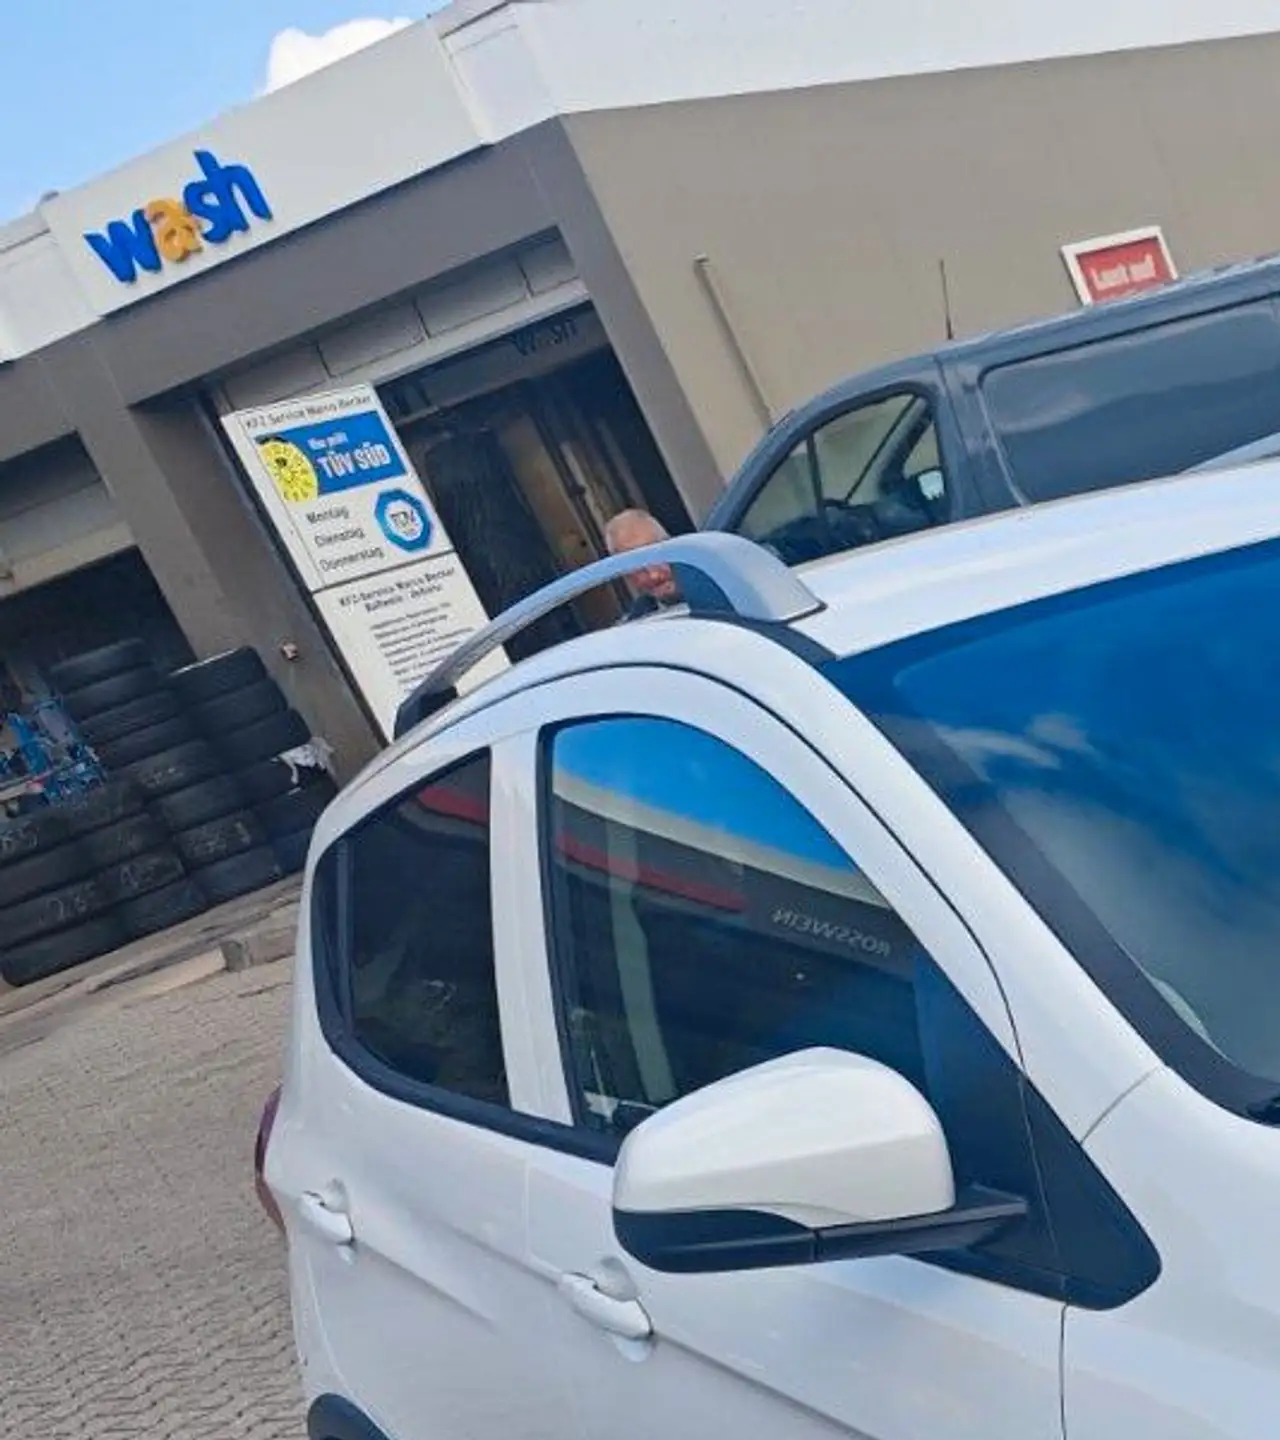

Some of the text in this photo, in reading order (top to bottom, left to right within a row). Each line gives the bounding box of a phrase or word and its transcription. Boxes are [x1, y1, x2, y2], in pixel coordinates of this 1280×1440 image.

[84, 149, 273, 283] wash
[316, 441, 391, 478] TÜV SÜD
[305, 506, 349, 524] Montag
